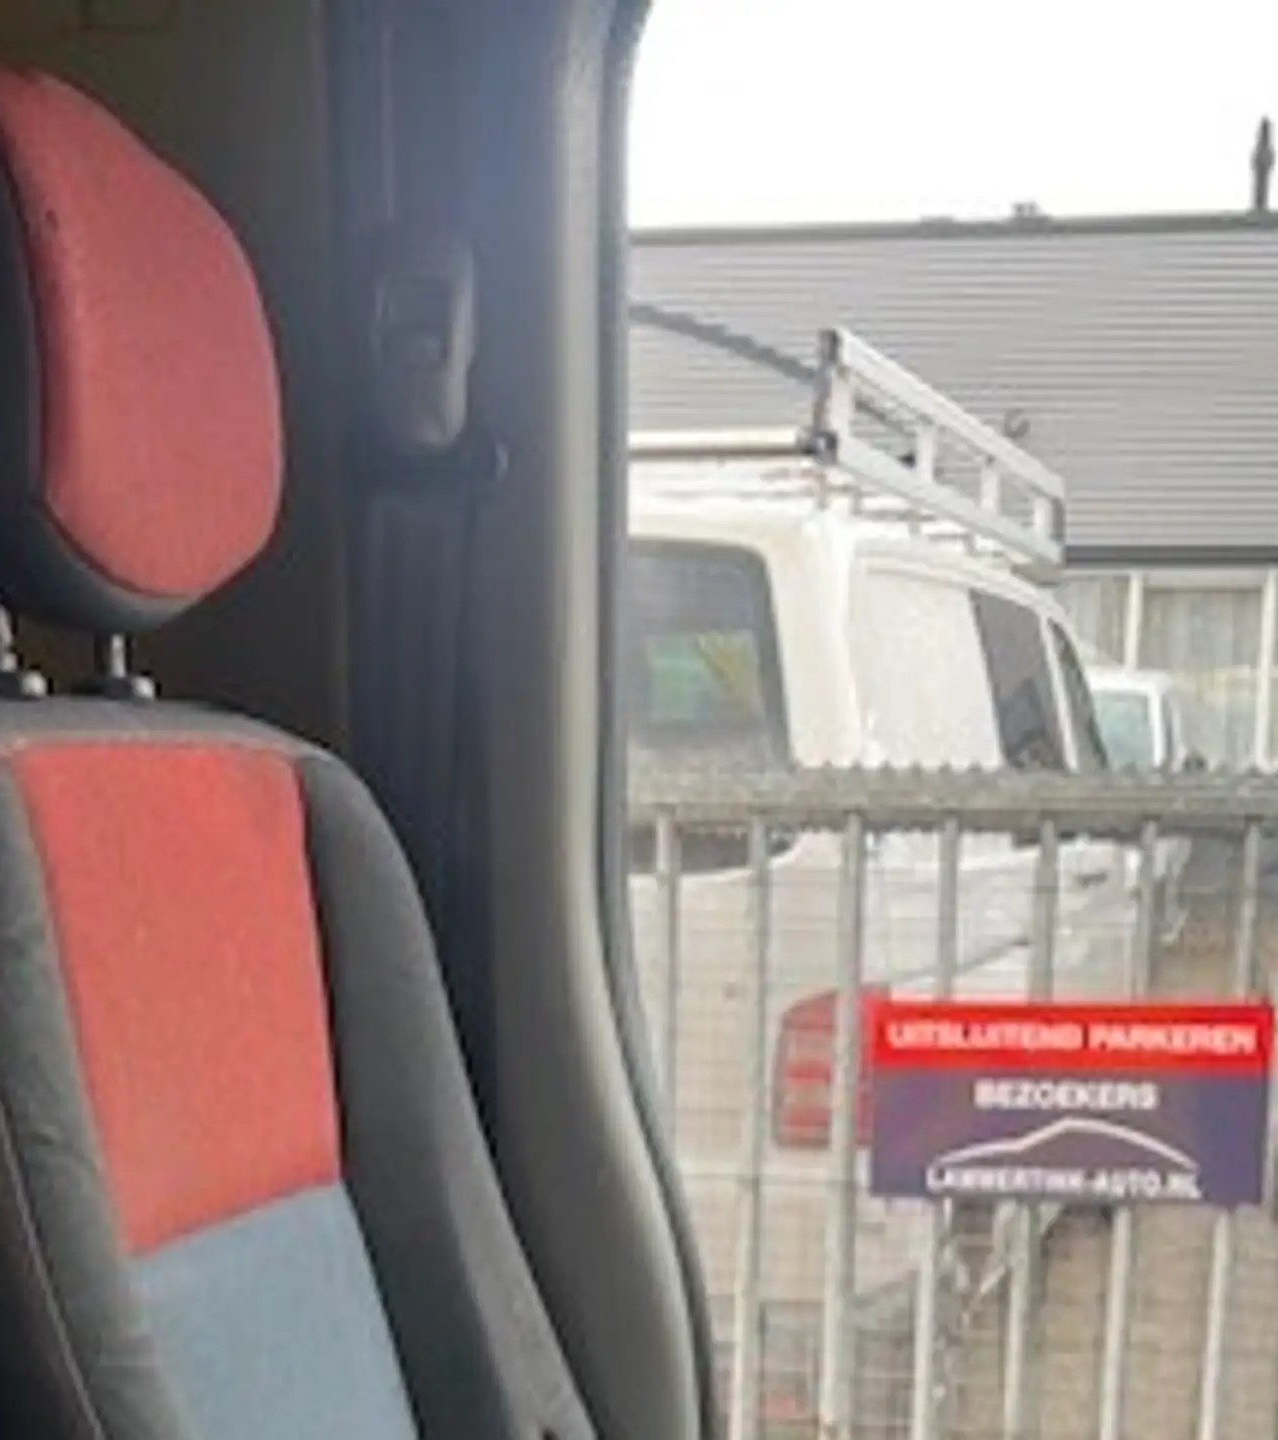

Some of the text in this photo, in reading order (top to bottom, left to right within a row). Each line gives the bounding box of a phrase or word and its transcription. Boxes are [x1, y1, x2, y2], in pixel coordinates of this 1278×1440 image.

[886, 1021, 1258, 1054] UITSLUITEND PARKEREN
[974, 1080, 1159, 1110] BEZOEKERS
